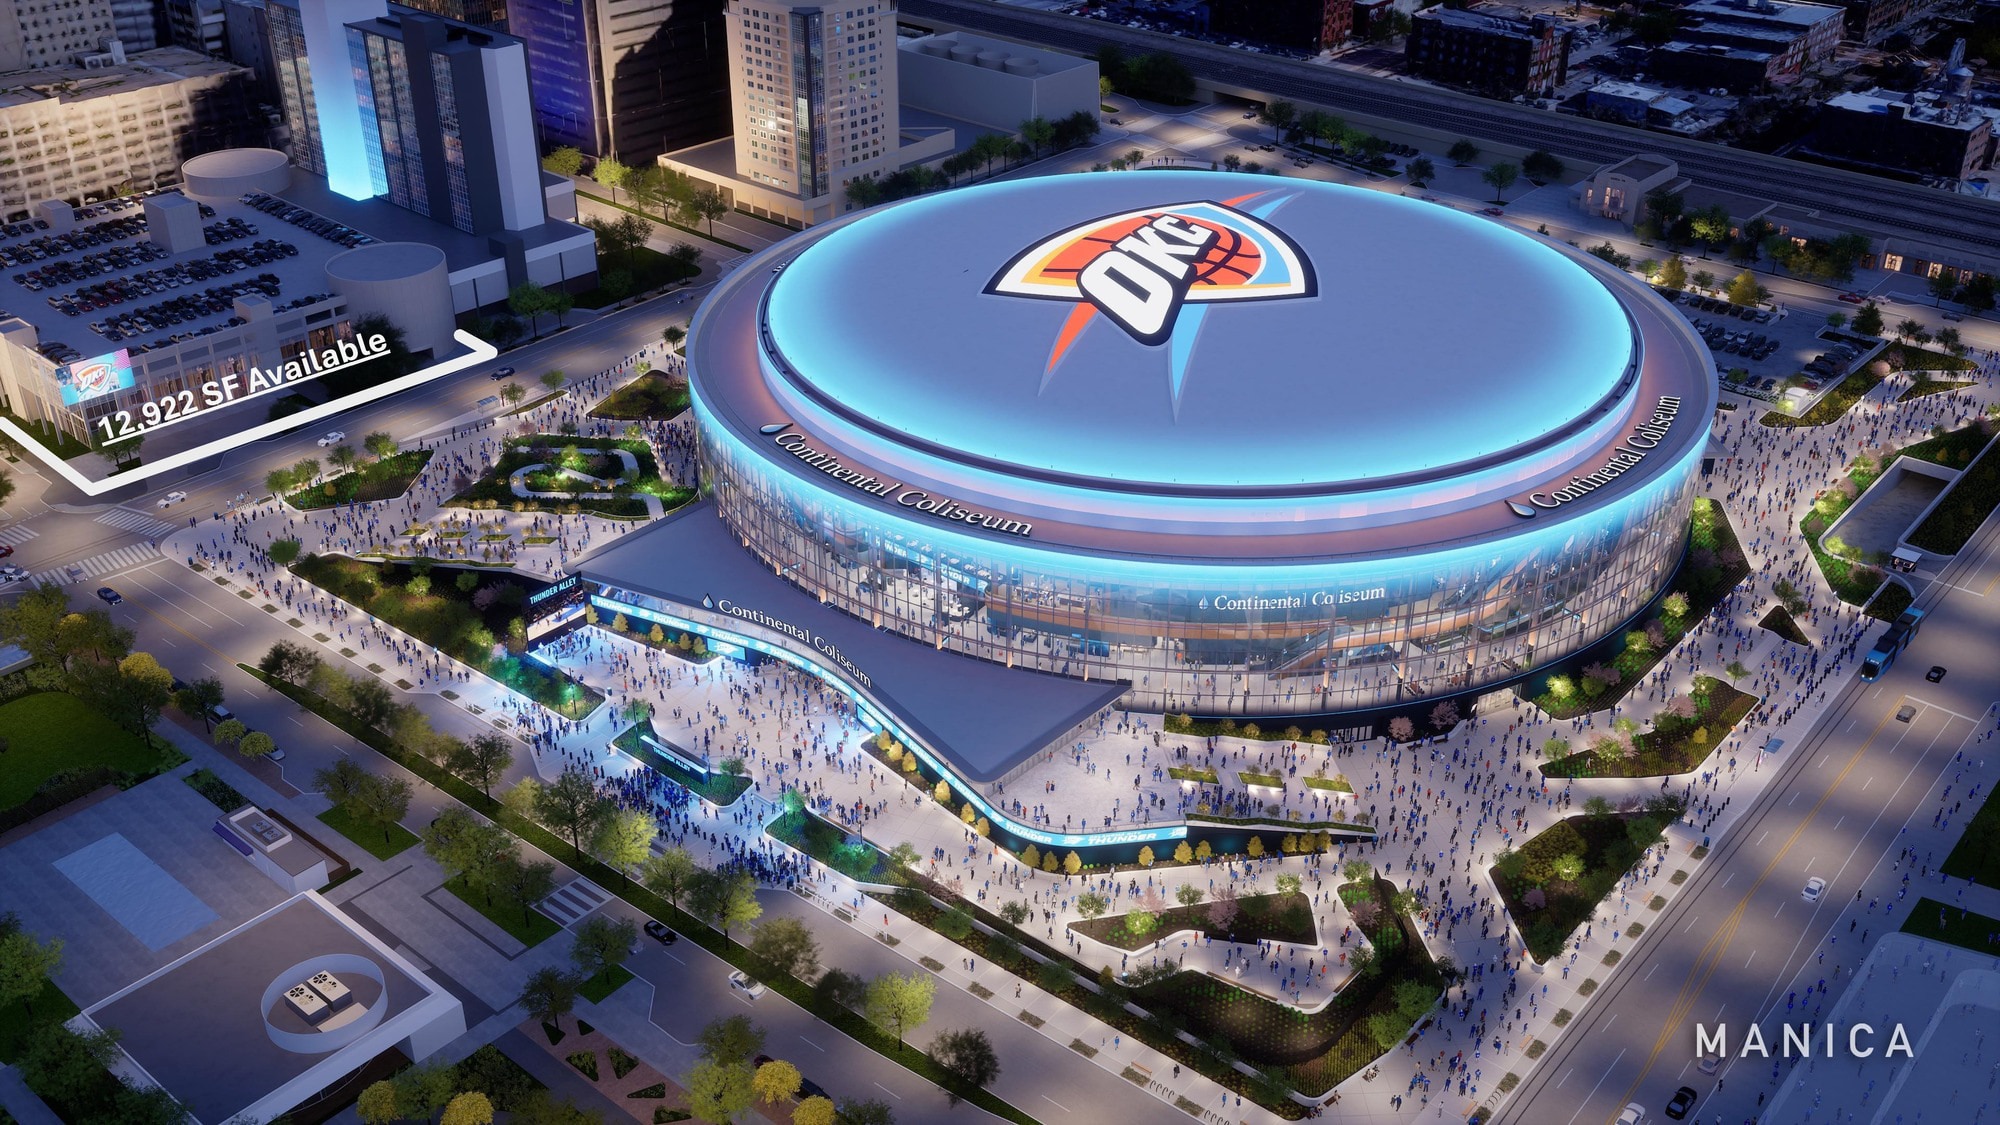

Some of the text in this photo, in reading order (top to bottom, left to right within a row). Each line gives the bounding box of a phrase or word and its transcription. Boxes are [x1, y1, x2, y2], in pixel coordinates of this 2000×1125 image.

[1080, 214, 1213, 335] OKC
[1529, 395, 1681, 508] Continental Coliseum
[774, 432, 1033, 536] Continental Coliseum
[530, 576, 577, 604] THUNDER ALLEY
[1312, 586, 1385, 606] Coiseum
[653, 614, 690, 630] THUNDER
[711, 630, 749, 646] THUNDER
[719, 600, 872, 689] Continental Coliseum
[1006, 820, 1052, 843] THUNDER
[1088, 832, 1157, 844] THUNDER
